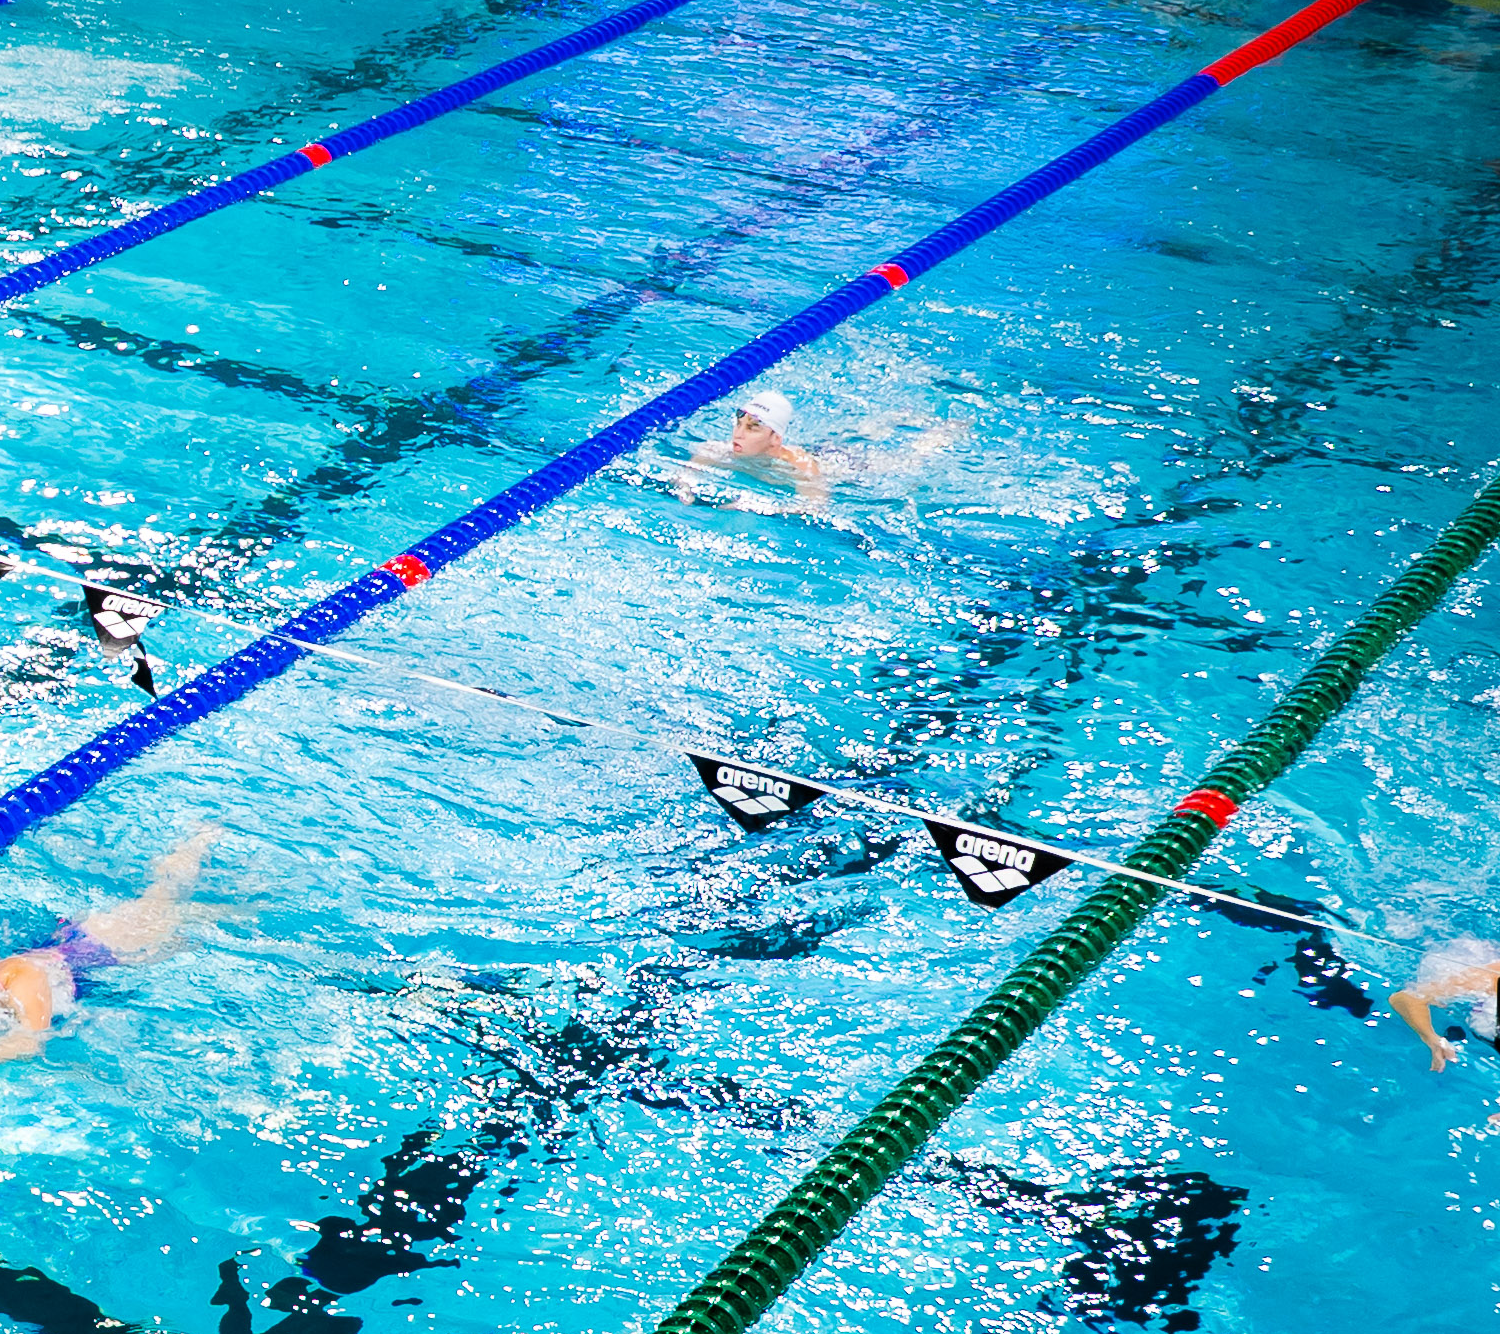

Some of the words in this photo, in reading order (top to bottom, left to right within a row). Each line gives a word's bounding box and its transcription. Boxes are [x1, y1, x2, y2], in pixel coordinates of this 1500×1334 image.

[101, 593, 167, 620] arena
[716, 764, 791, 802] arena
[954, 833, 1036, 873] arena
